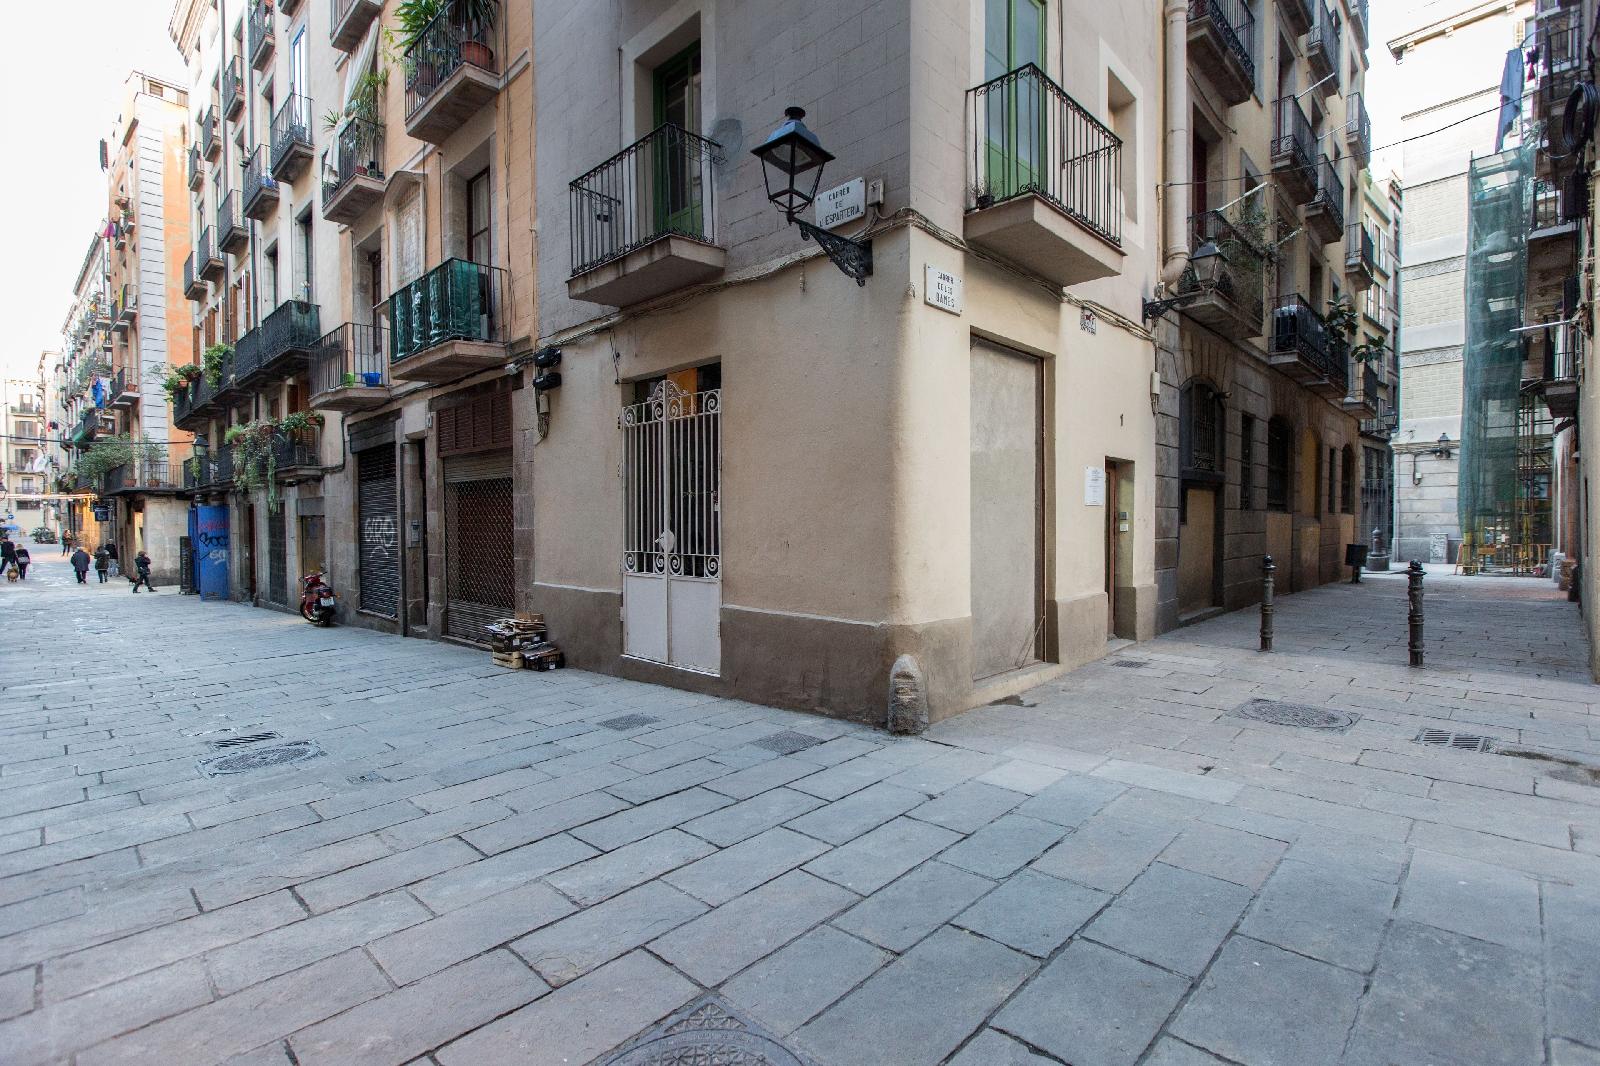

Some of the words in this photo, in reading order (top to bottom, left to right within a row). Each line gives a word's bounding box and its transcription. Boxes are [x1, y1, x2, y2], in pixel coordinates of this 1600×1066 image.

[829, 186, 850, 201] CARRER
[835, 200, 843, 209] DE
[937, 282, 944, 291] DE
[936, 292, 955, 308] DAMES
